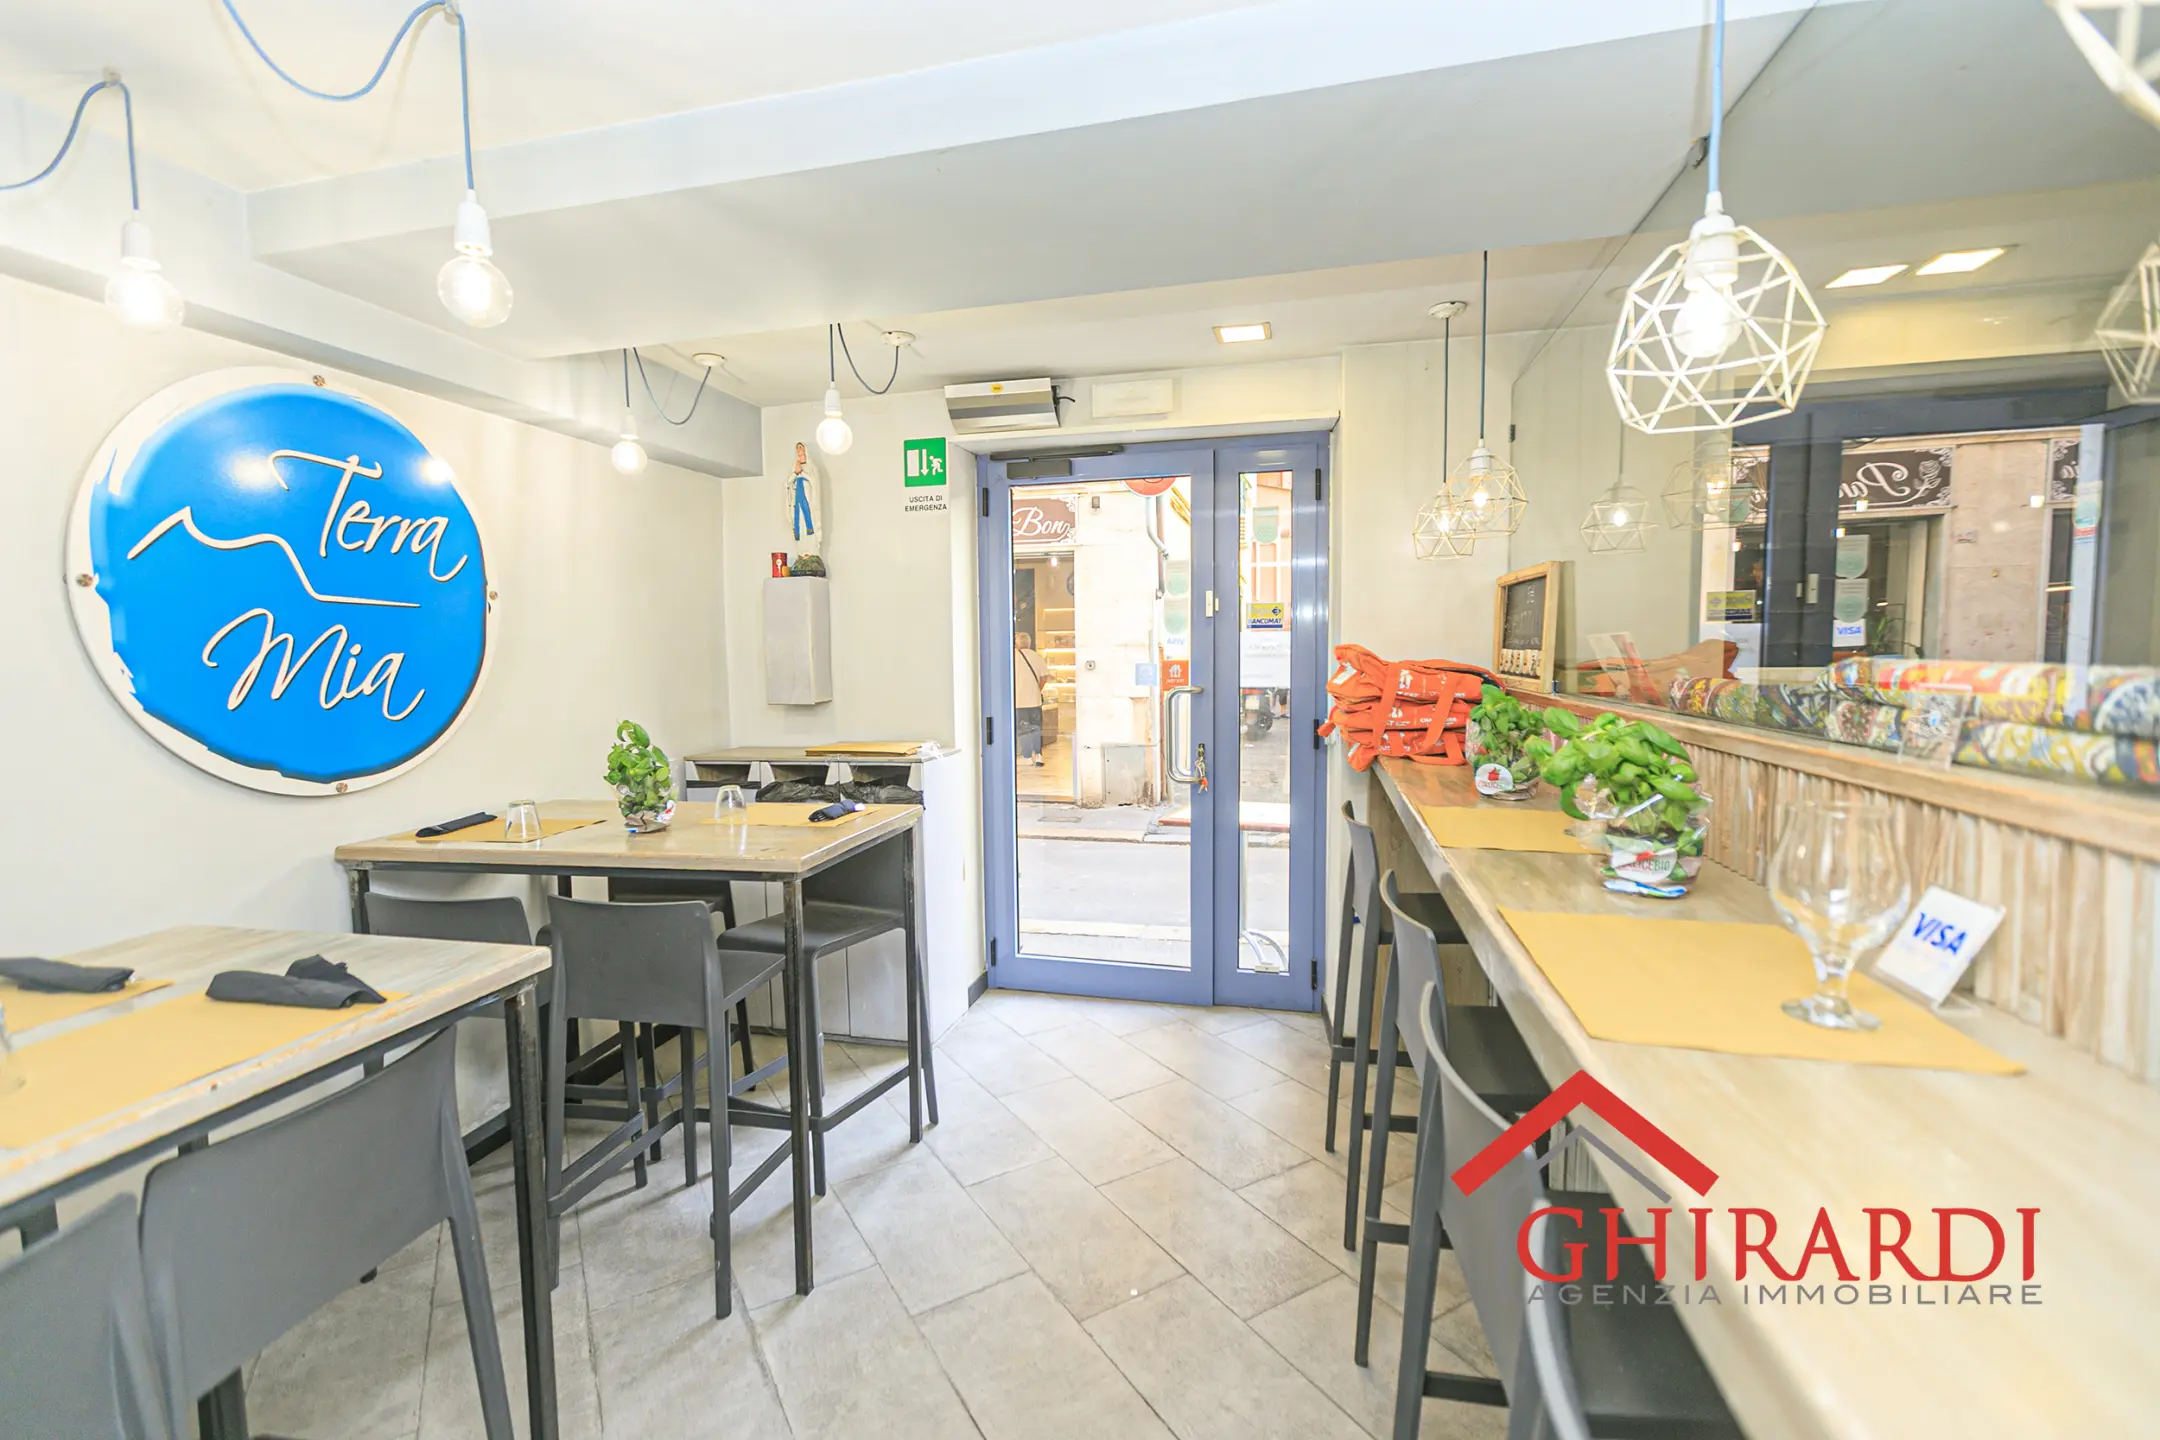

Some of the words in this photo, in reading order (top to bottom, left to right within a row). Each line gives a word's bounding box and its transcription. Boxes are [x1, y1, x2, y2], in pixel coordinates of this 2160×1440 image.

[267, 448, 469, 583] Terra
[904, 503, 948, 512] EMERGENZA
[908, 495, 934, 504] USCITA
[935, 494, 943, 502] DI
[201, 607, 426, 722] Mia
[1912, 911, 1968, 955] VISA
